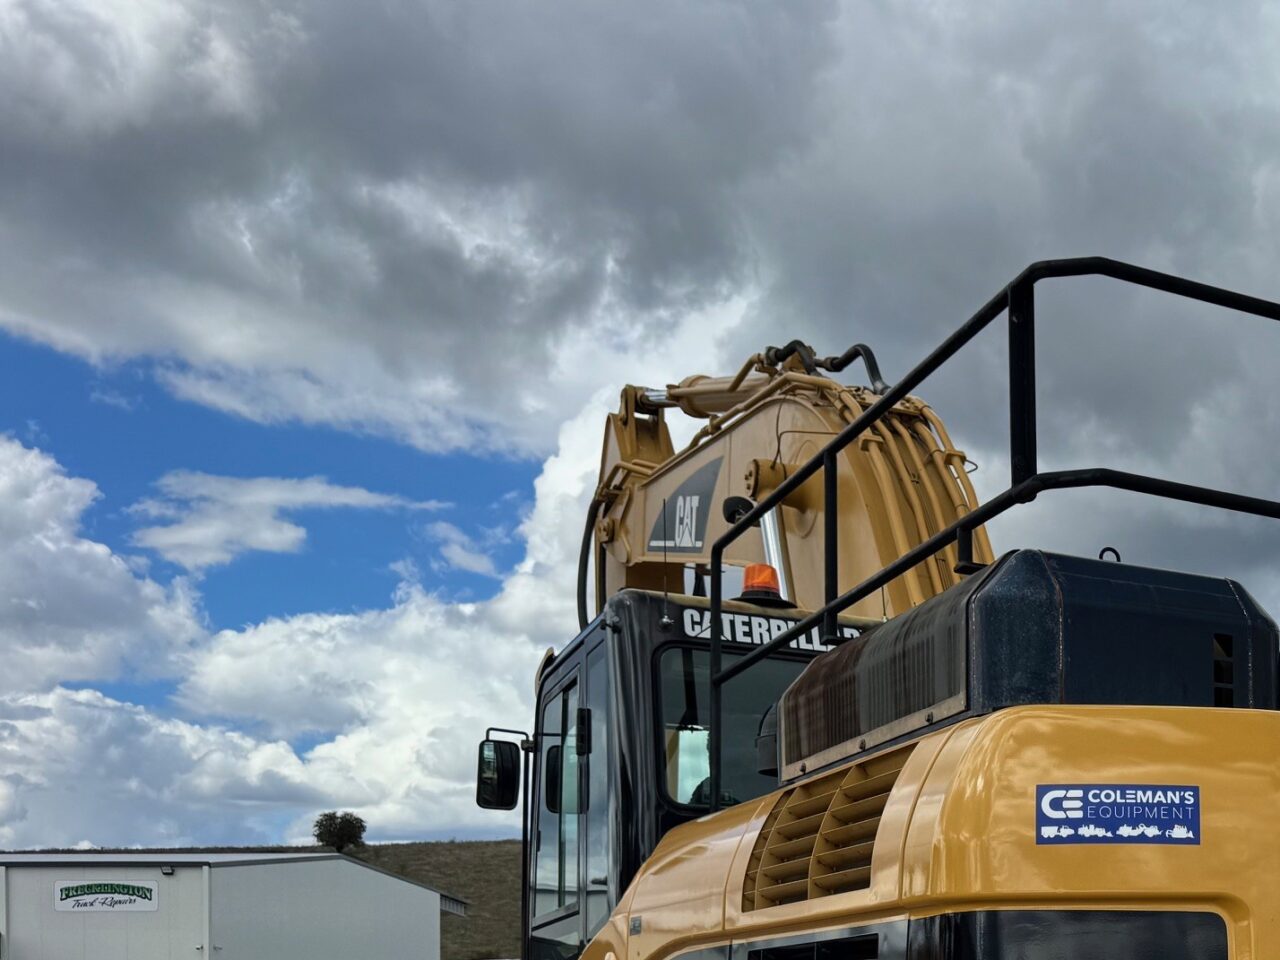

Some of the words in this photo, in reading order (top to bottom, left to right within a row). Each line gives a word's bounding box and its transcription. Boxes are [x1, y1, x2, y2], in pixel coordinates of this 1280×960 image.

[675, 496, 700, 547] CAT
[683, 608, 861, 652] CATERPILLR
[1087, 789, 1195, 805] COLEMAN'S
[1087, 805, 1195, 819] EQUIPMENT
[60, 883, 153, 902] FRECKLINGTON
[72, 897, 99, 908] Truck
[99, 896, 137, 908] Repairs
